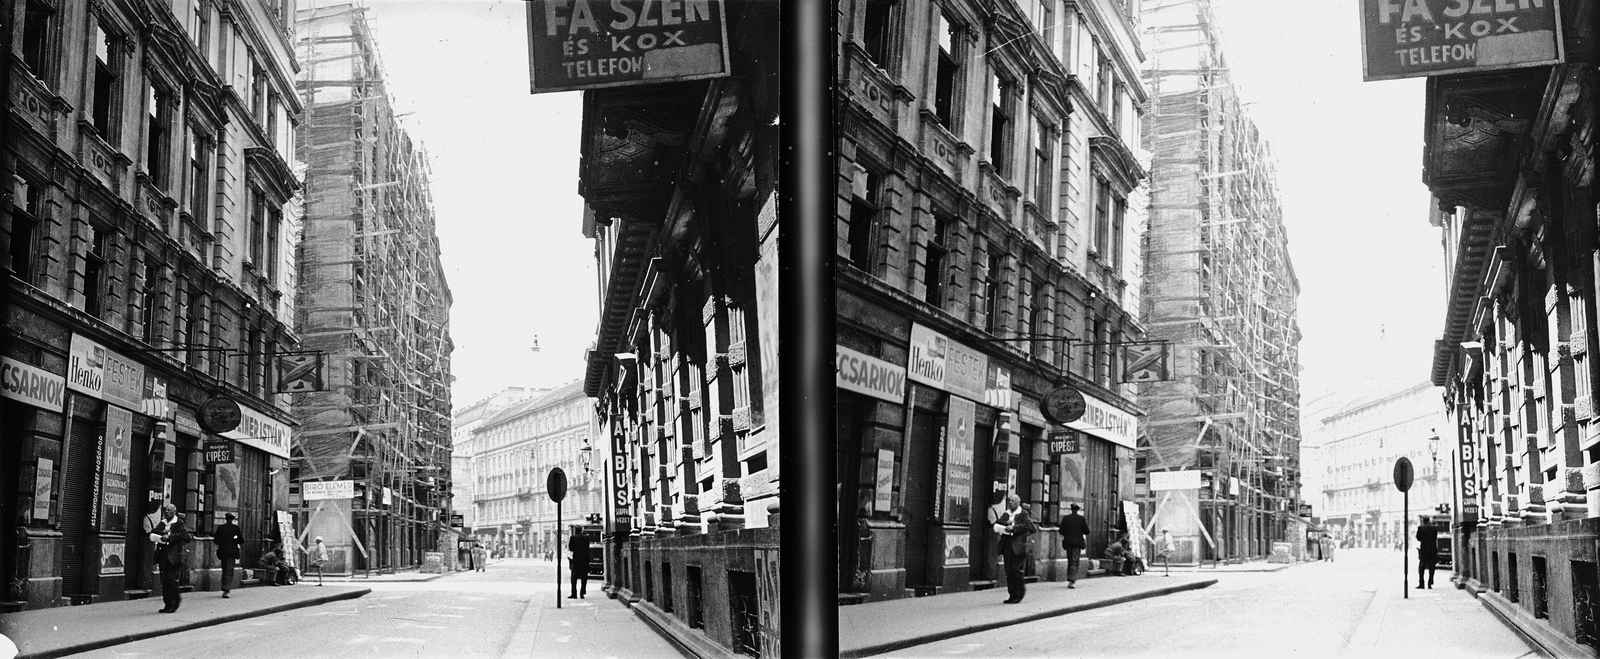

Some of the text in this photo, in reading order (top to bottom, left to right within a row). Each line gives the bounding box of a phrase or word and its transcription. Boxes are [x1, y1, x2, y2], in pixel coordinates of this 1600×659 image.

[544, 0, 600, 36] FA
[1394, 16, 1520, 43] ÉS KOX
[562, 30, 687, 56] ÉS KOX
[1395, 42, 1476, 67] TELEFON
[562, 56, 643, 79] TELEFON
[70, 355, 101, 392] Henko
[839, 354, 905, 398] CSARNOK
[911, 346, 943, 382] Henko
[1, 363, 64, 407] CSARNOK
[613, 420, 628, 506] ALBUS
[1461, 410, 1475, 496] ALBUS
